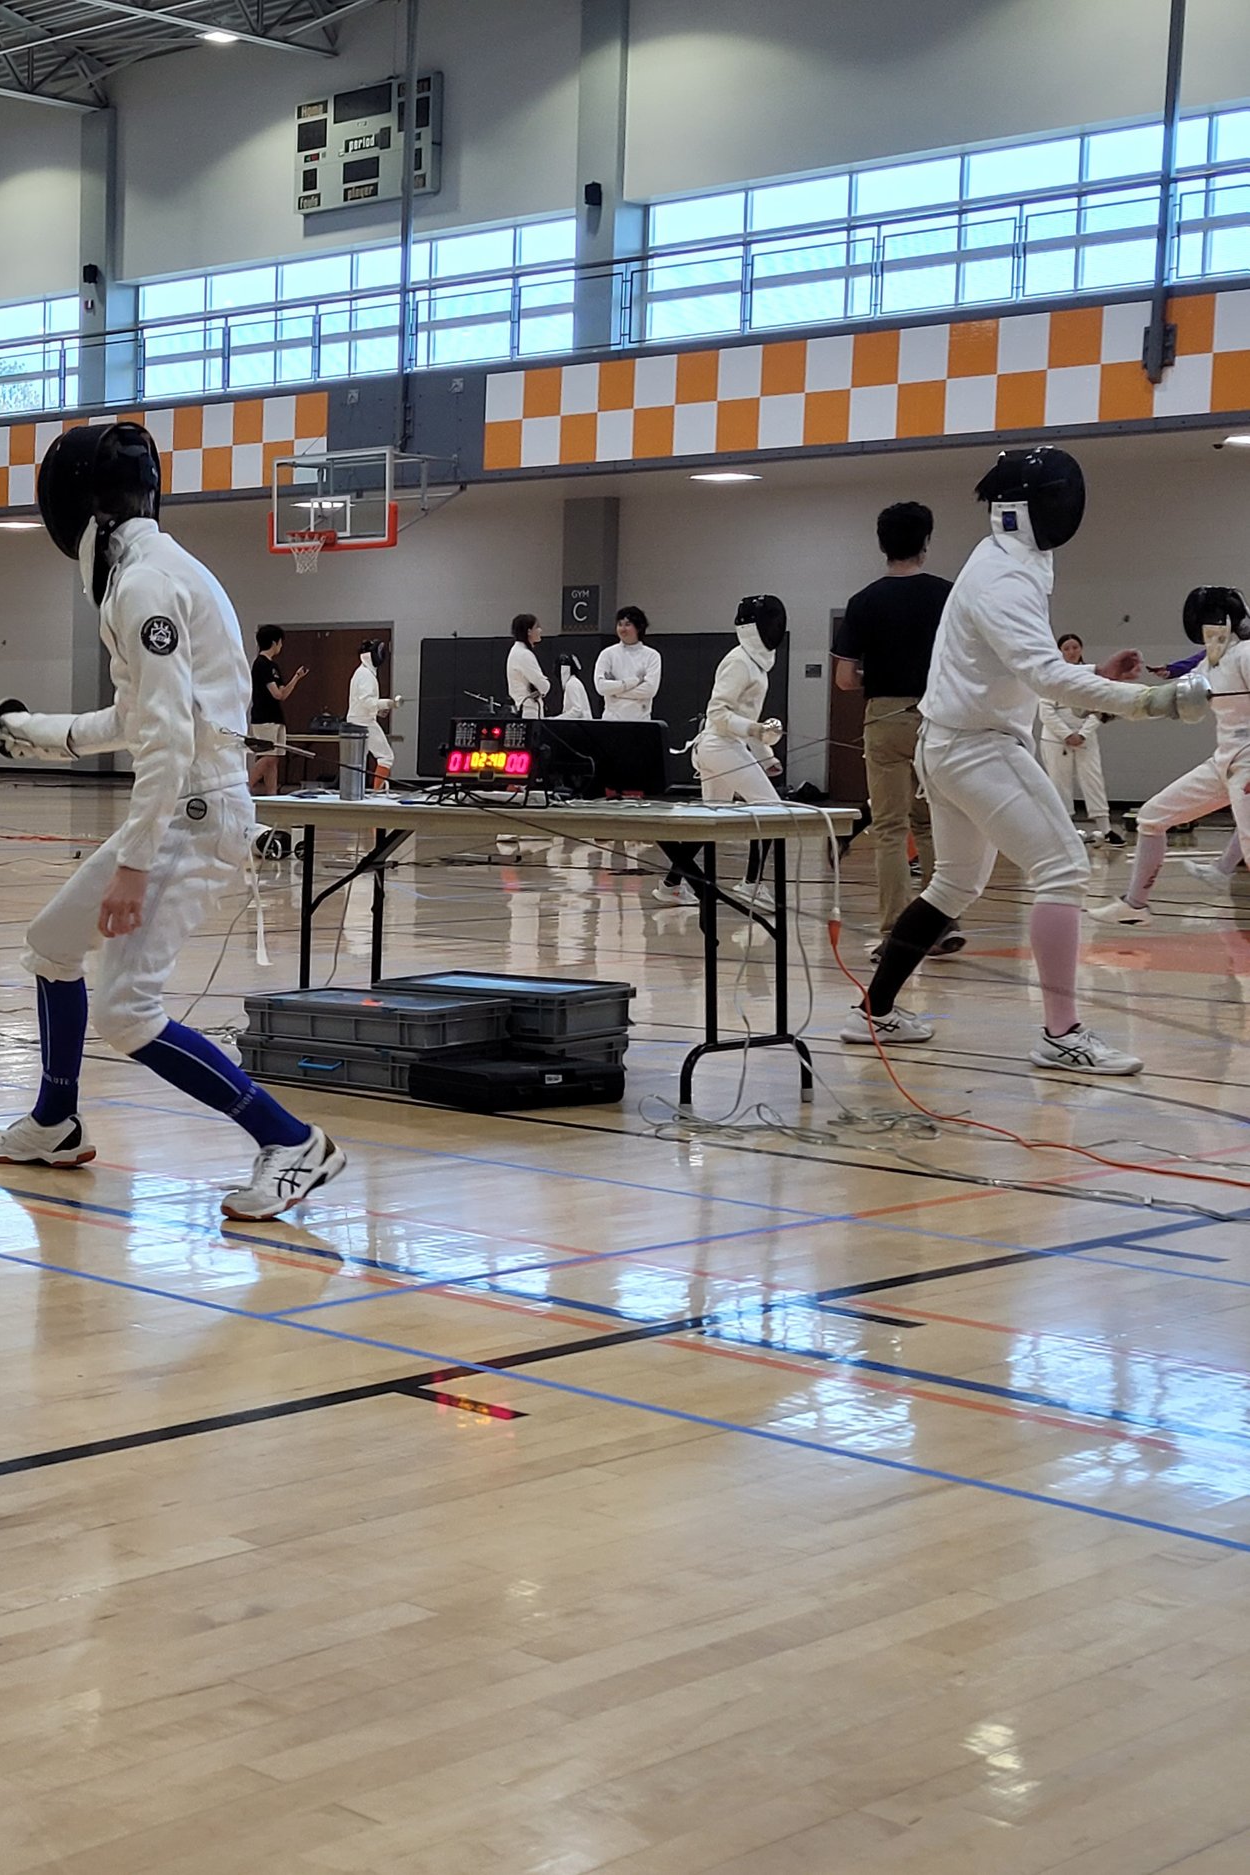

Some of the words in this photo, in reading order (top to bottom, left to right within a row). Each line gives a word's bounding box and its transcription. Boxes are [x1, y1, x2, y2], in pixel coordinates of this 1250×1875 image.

[348, 135, 375, 152] period
[347, 184, 374, 201] player
[571, 590, 589, 599] GYM
[573, 601, 588, 621] C
[505, 752, 530, 773] 00
